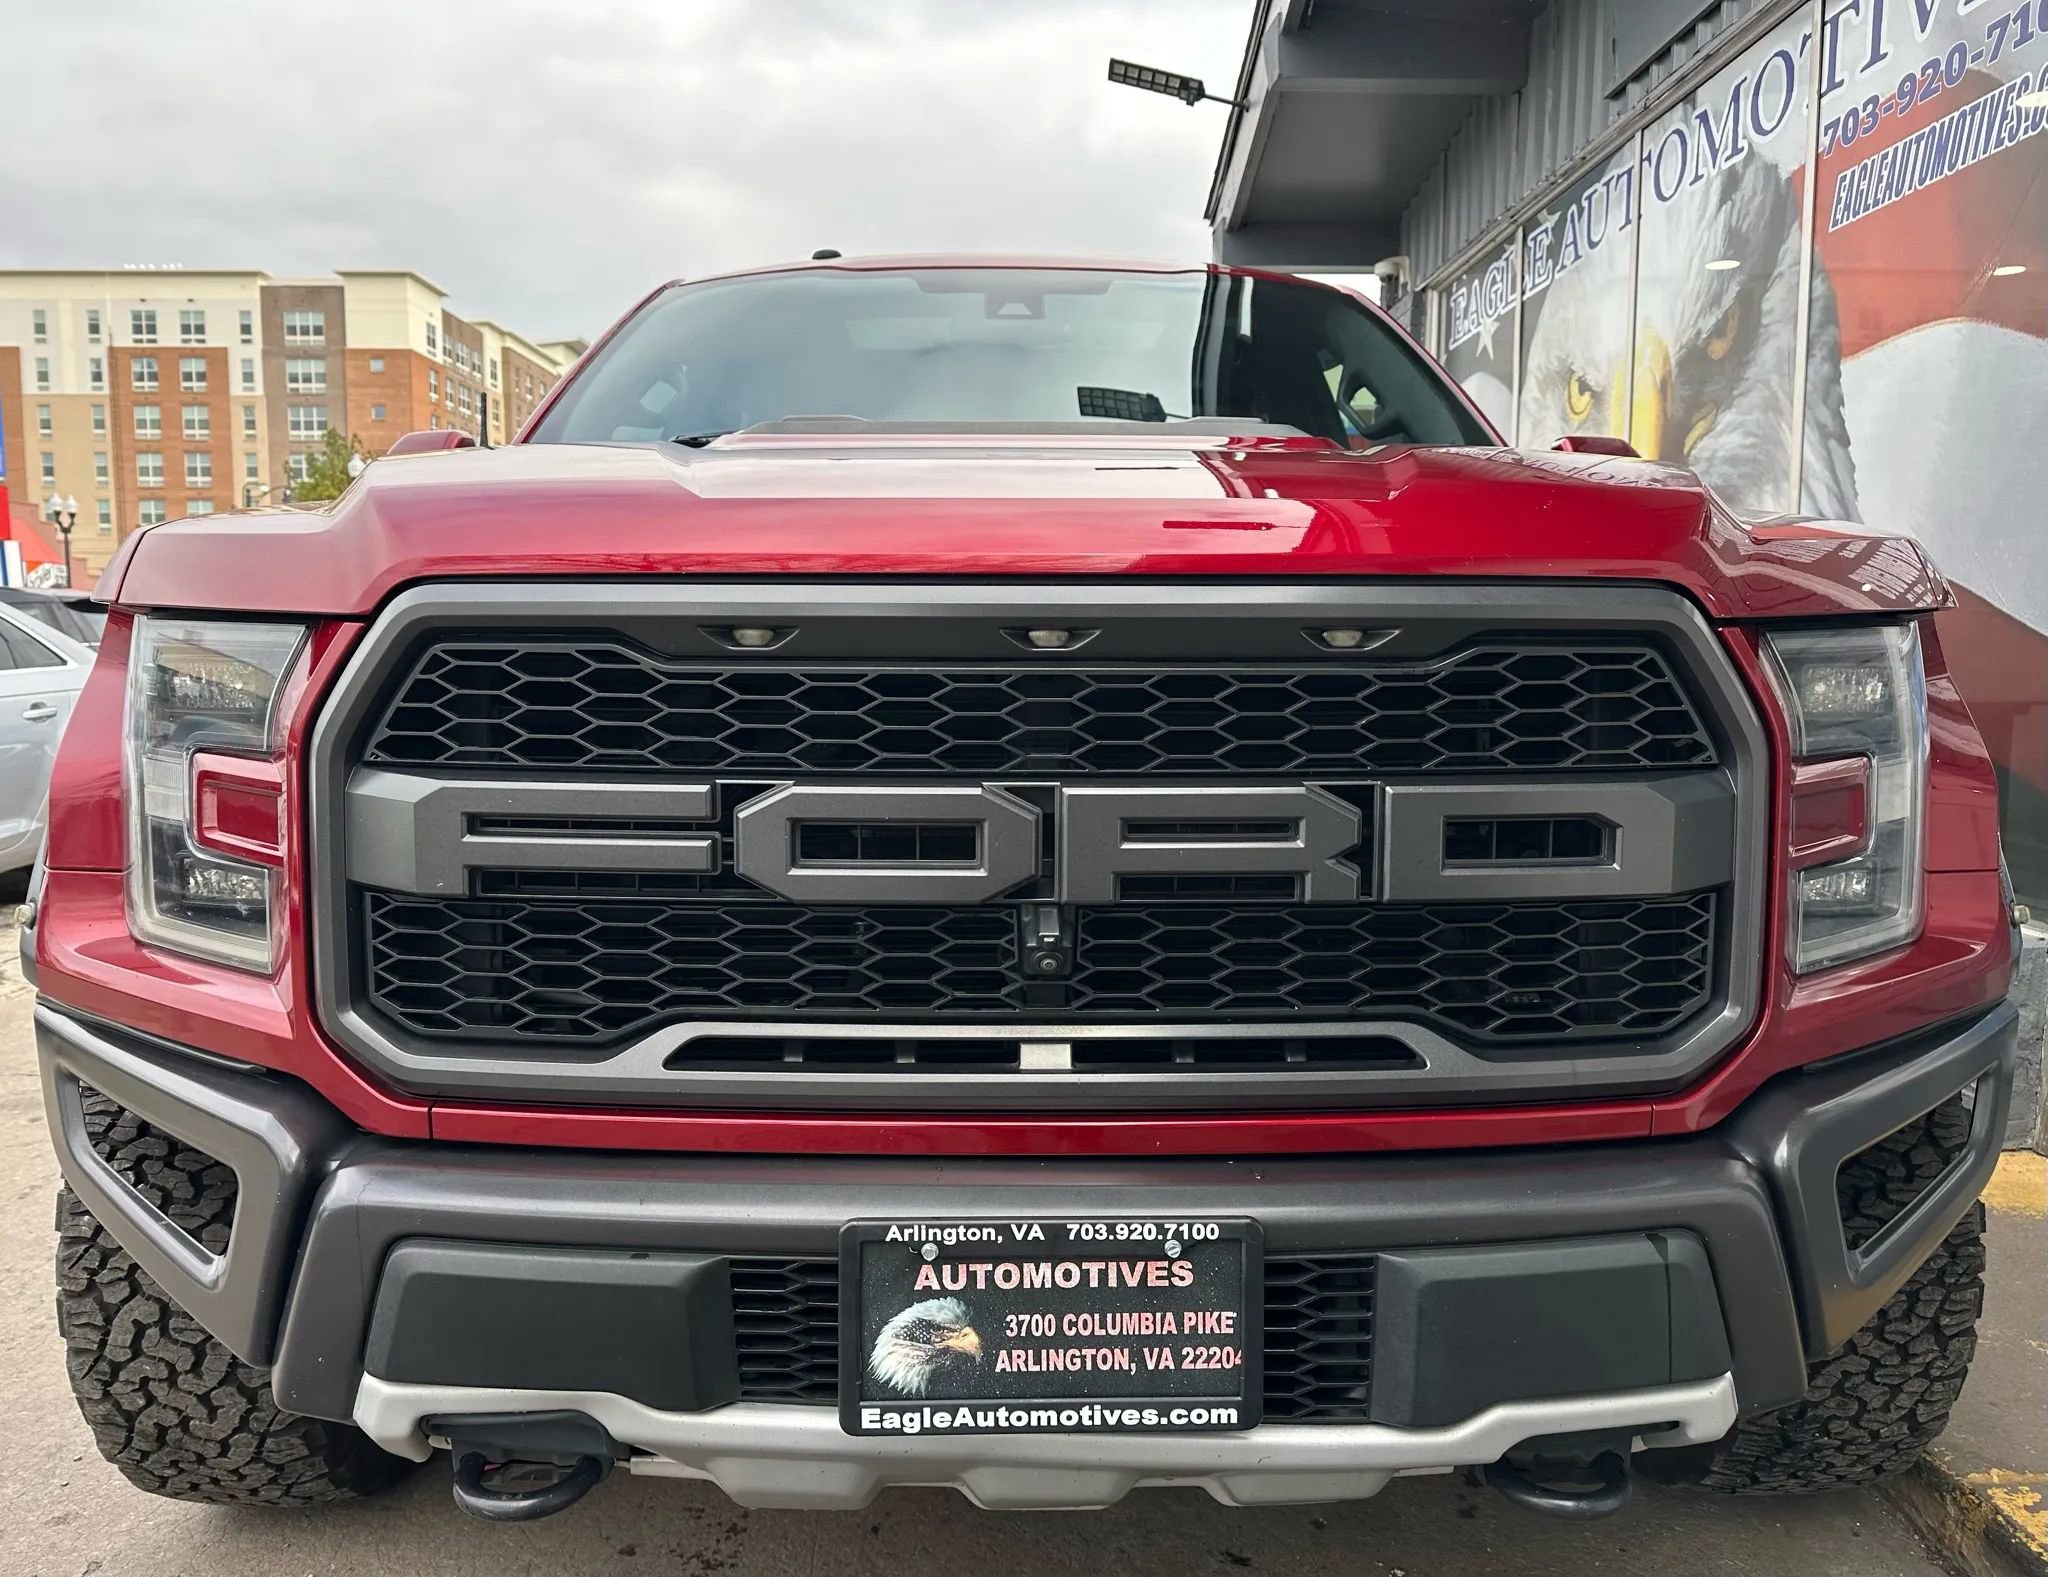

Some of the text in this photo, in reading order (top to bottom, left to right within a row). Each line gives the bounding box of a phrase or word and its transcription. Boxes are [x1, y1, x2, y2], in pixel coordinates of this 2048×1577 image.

[1449, 222, 1553, 349] EAGLE
[405, 777, 1692, 904] FORD
[885, 1223, 1220, 1246] Arlington, VA 703.920.7100
[913, 1260, 1195, 1291] AUTOMOTIVES
[1005, 1311, 1236, 1337] 3700 COLUMBIA PIKE
[994, 1348, 1137, 1375] ARLINGTON,
[1143, 1347, 1176, 1371] VA
[860, 1405, 1238, 1434] EagleAutomotives.com
